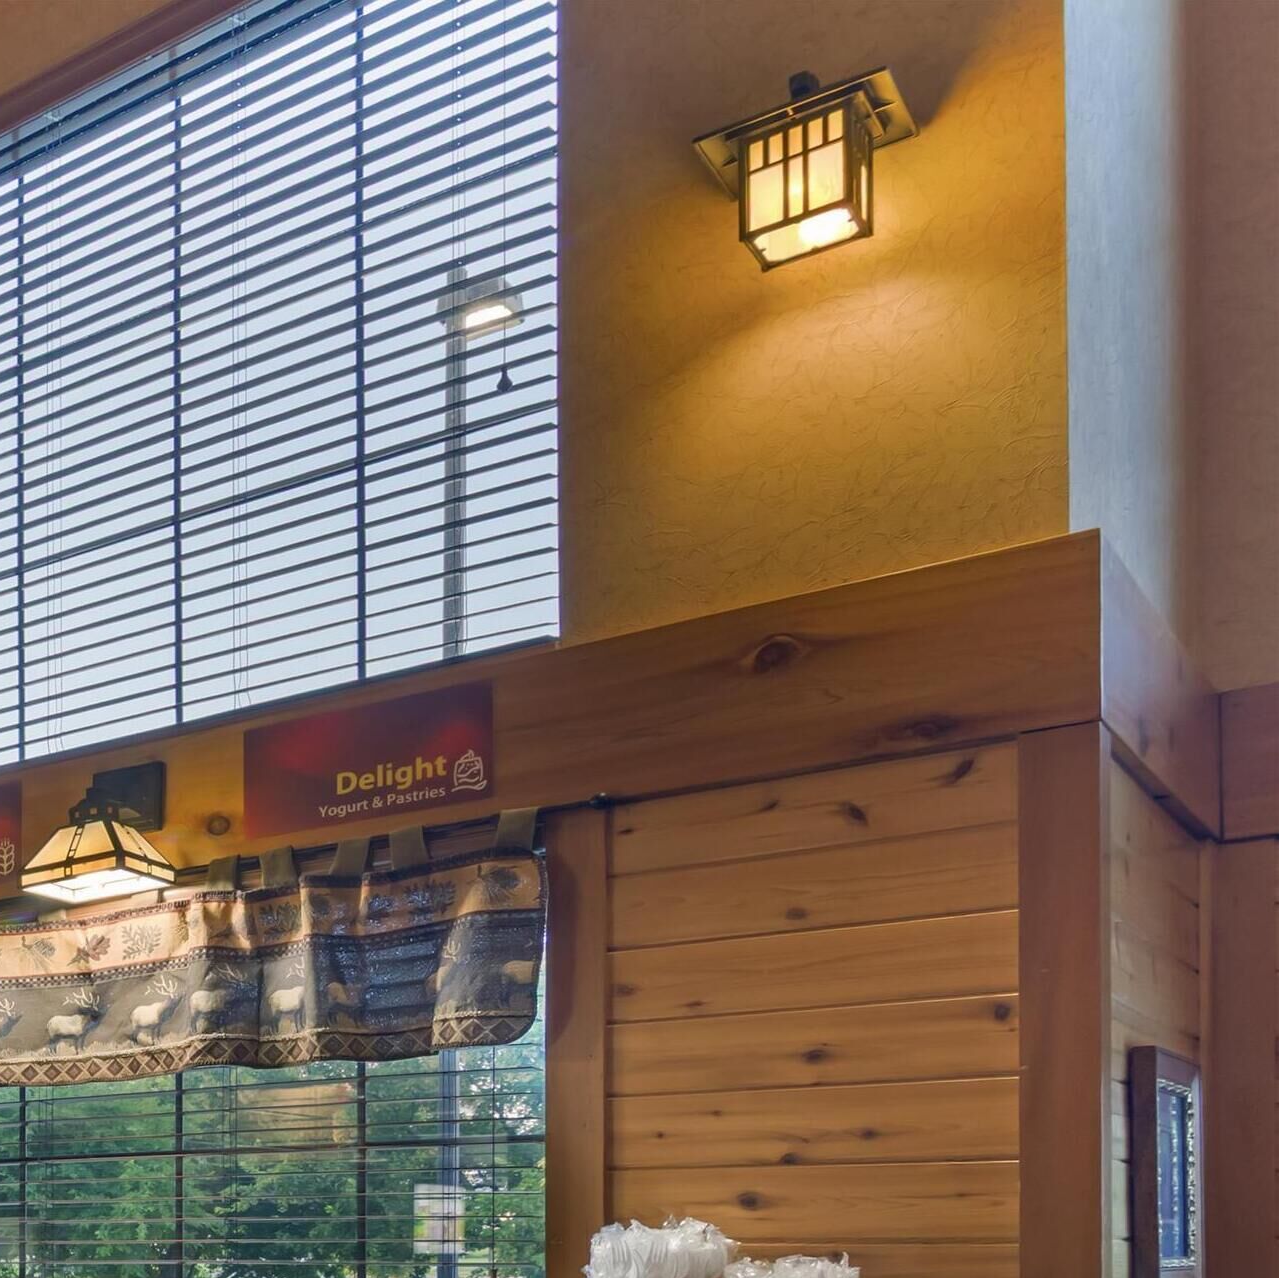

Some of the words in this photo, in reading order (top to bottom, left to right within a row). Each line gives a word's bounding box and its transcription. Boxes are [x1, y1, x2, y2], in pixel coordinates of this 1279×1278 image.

[336, 755, 447, 795] Delight
[319, 799, 368, 818] Yogurt
[372, 796, 384, 808] &
[387, 786, 446, 806] Pastries
